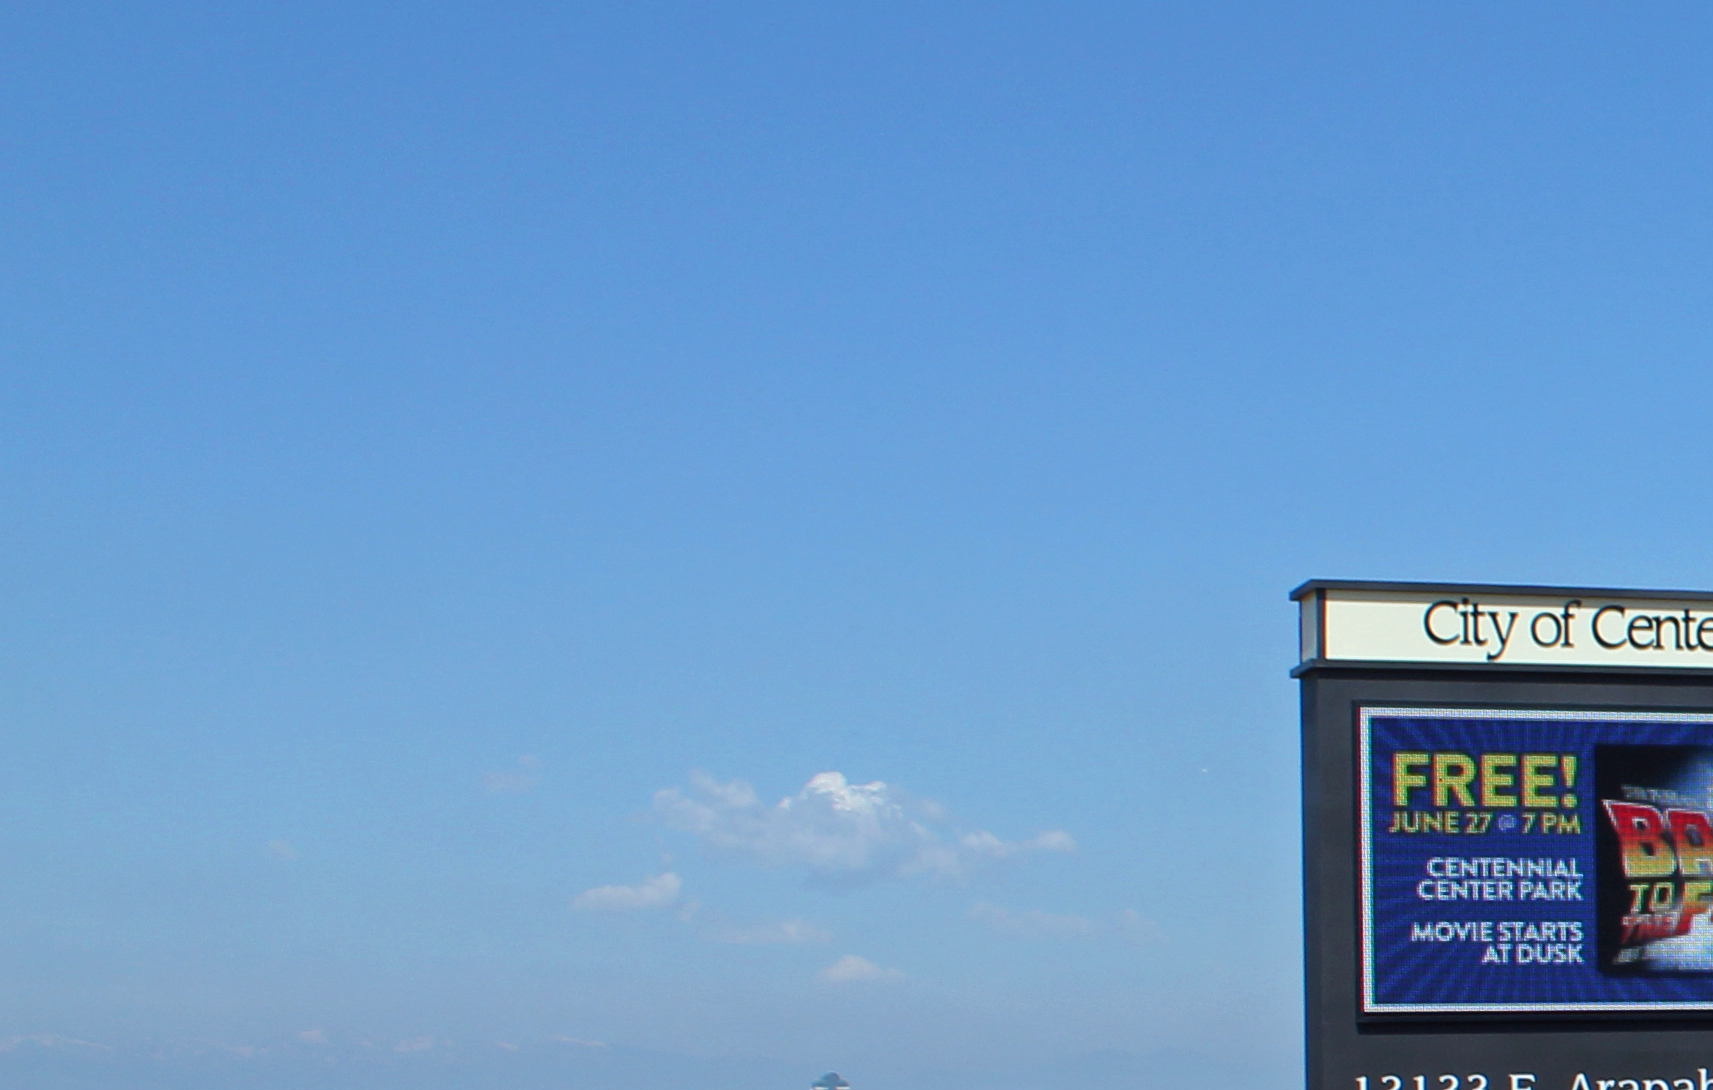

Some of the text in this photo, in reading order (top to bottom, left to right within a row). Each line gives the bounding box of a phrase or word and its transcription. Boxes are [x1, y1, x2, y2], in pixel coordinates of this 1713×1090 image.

[1423, 598, 1518, 661] City
[1530, 600, 1581, 648] of
[1392, 752, 1577, 808] FREE!
[1389, 811, 1460, 834] JUNE
[1464, 812, 1493, 834] 27
[1521, 813, 1536, 834] 7
[1541, 812, 1581, 834] PM
[1426, 857, 1584, 877] CENTENNIAL
[1416, 879, 1584, 901] CENTER PARK
[1629, 884, 1674, 913] TO
[1411, 921, 1584, 942] MOVIE STARTS
[1481, 943, 1585, 965] AT DUSK
